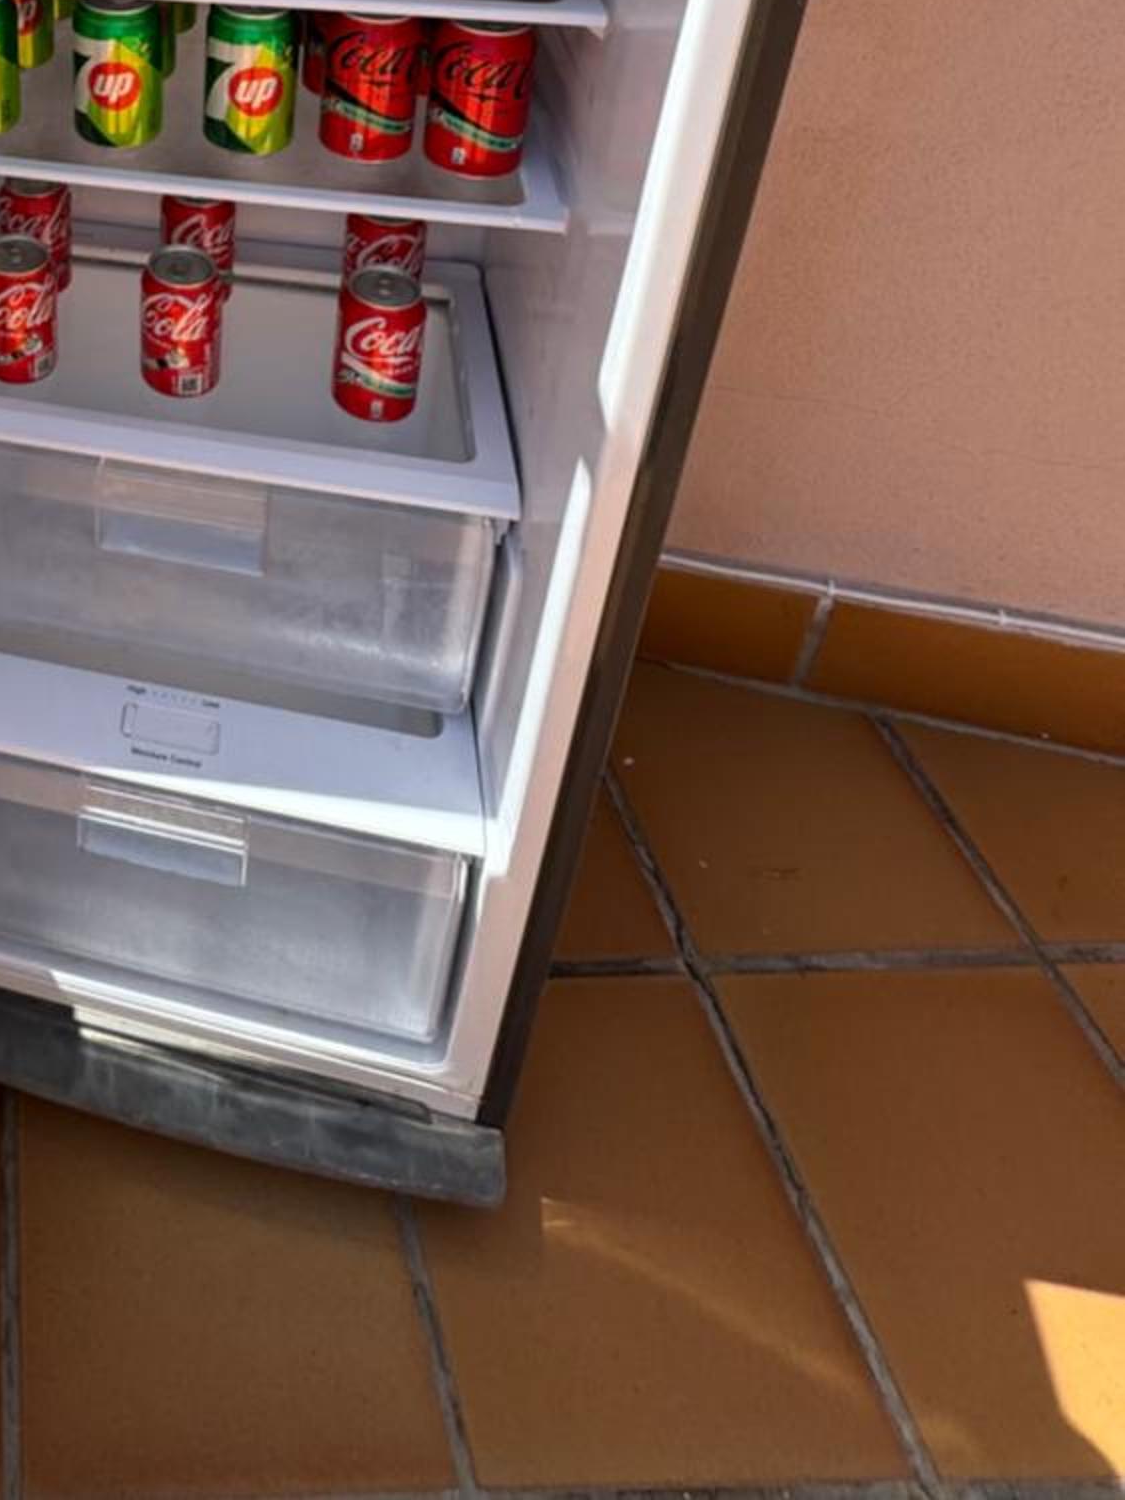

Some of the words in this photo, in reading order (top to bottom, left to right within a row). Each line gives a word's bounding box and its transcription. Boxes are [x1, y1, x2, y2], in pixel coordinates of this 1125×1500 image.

[93, 71, 135, 102] up
[232, 76, 278, 106] up
[345, 317, 421, 358] Coca
